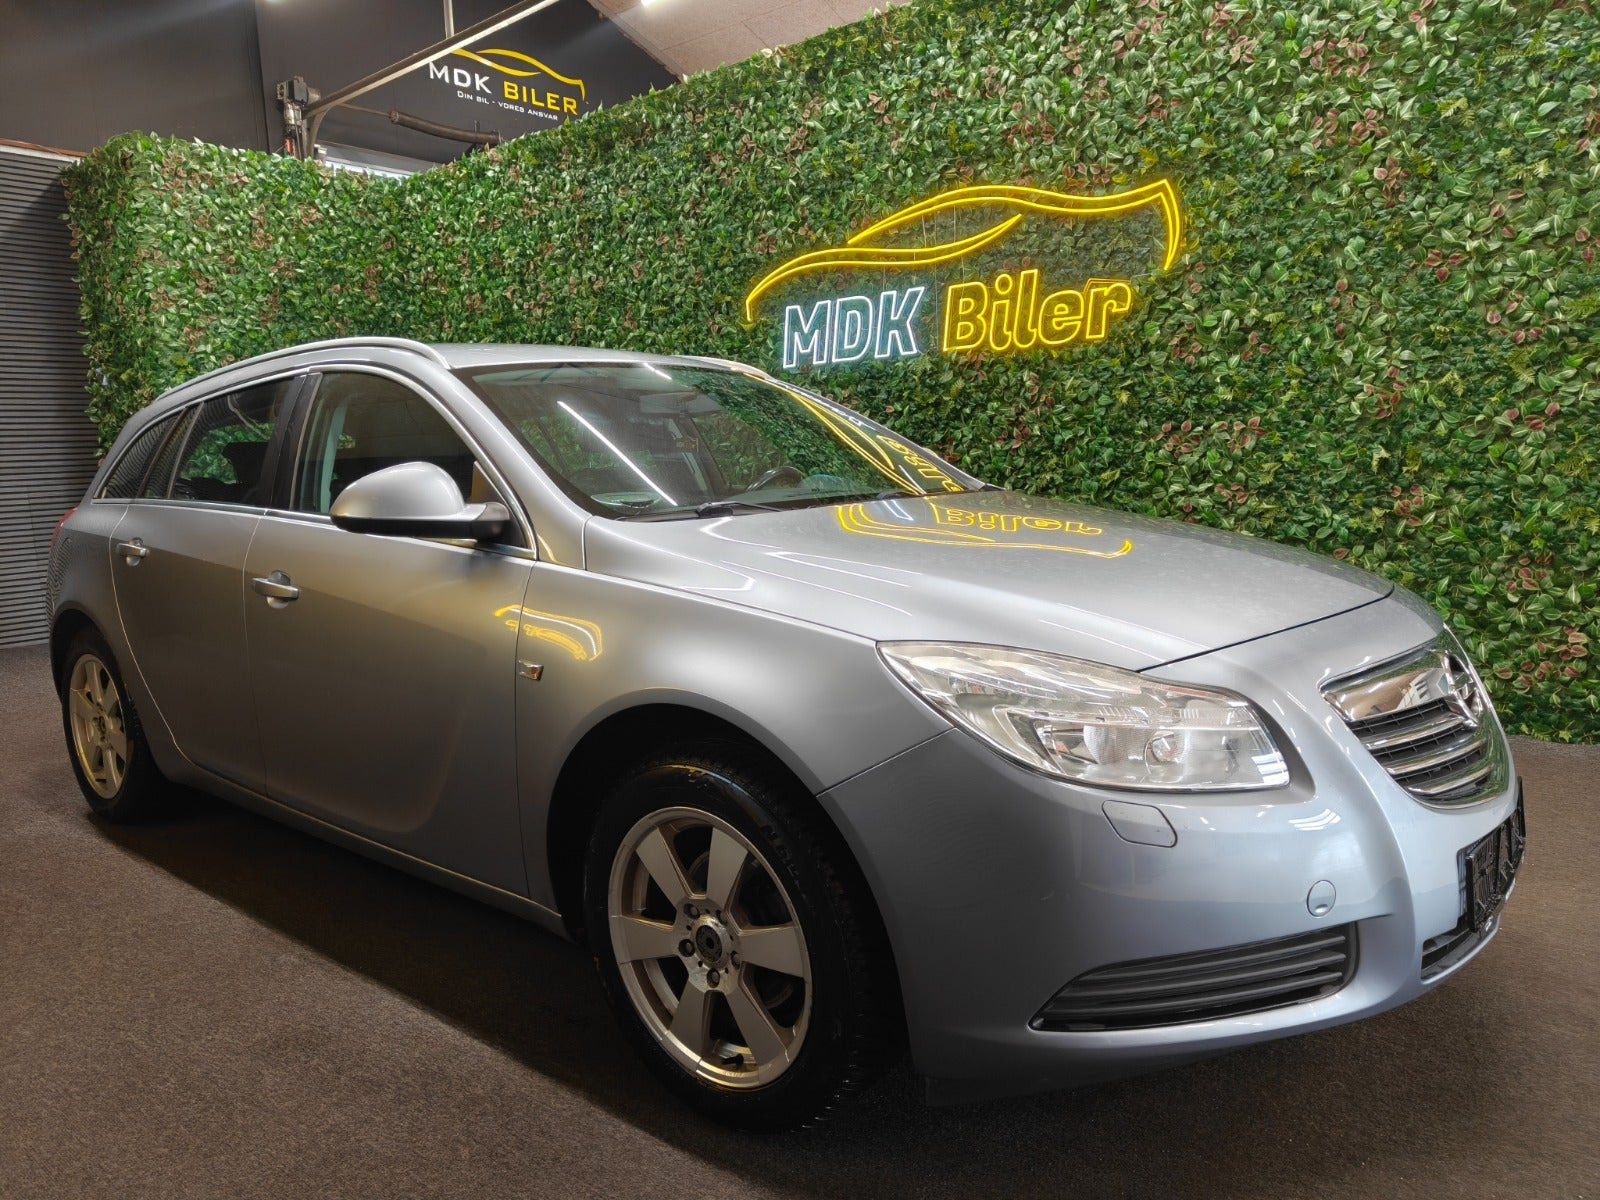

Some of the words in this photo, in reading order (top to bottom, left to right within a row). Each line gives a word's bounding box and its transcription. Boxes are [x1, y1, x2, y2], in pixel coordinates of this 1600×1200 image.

[429, 61, 492, 94] MDK
[503, 80, 578, 116] BILER
[782, 286, 926, 370] MDK
[942, 268, 1133, 354] Biler
